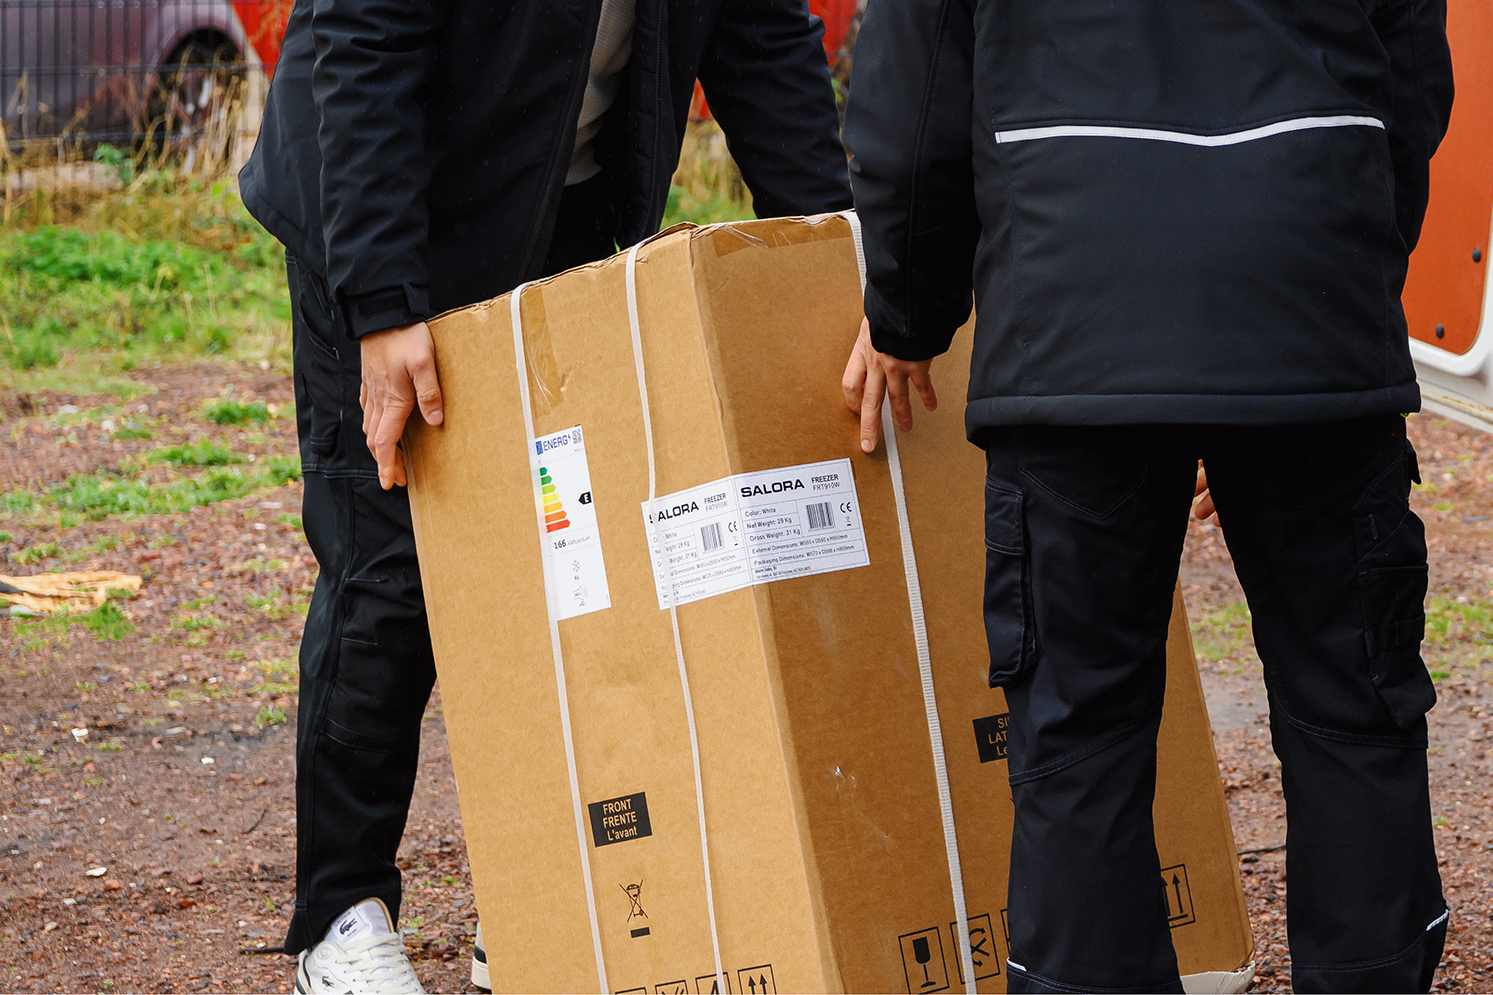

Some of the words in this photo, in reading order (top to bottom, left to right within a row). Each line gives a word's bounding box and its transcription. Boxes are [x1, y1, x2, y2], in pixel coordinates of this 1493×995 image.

[811, 474, 839, 483] FREEZER
[741, 479, 805, 497] SALORA
[584, 494, 589, 503] E
[704, 493, 726, 504] FREEZER
[745, 509, 761, 517] Color:
[757, 519, 776, 527] Weight:
[750, 533, 766, 541] Gross
[766, 529, 785, 539] Weight:
[793, 528, 800, 536] Kg
[554, 539, 566, 549] 166
[997, 717, 1009, 728] SI
[603, 799, 631, 815] FRONT
[602, 811, 637, 828] FRENTE
[607, 826, 637, 841] L'avant
